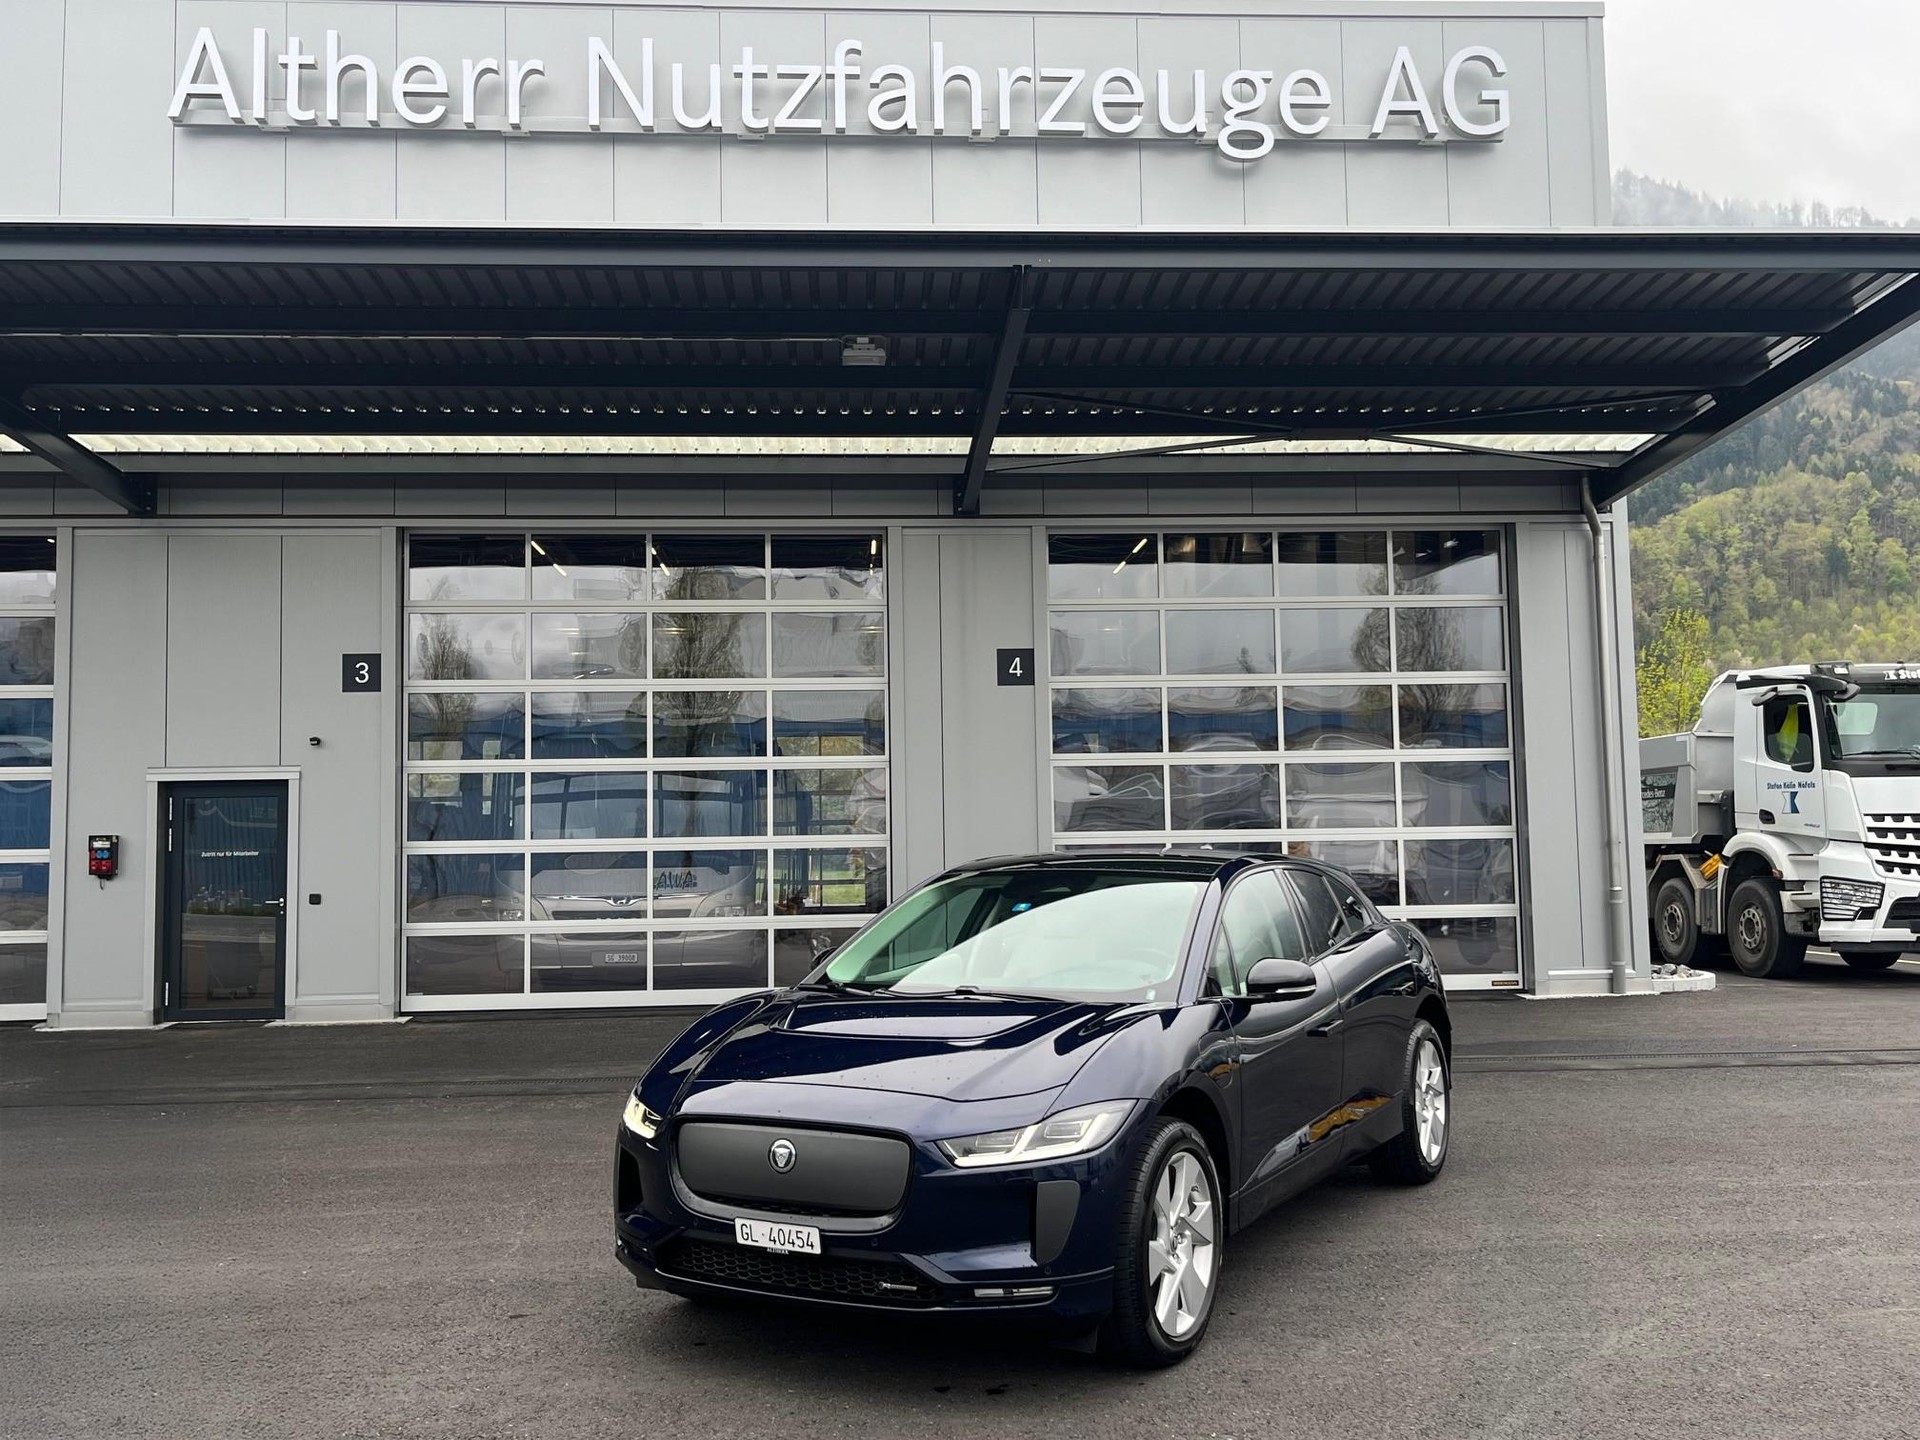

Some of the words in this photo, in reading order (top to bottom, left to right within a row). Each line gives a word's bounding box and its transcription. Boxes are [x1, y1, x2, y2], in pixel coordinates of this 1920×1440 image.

[167, 27, 546, 130] Altherr
[586, 36, 1332, 160] Nutzfahrzeuge
[1370, 45, 1512, 139] AG
[355, 662, 369, 684] 3
[1009, 657, 1023, 677] 4
[740, 1223, 759, 1243] GL
[768, 1227, 814, 1250] 40454
